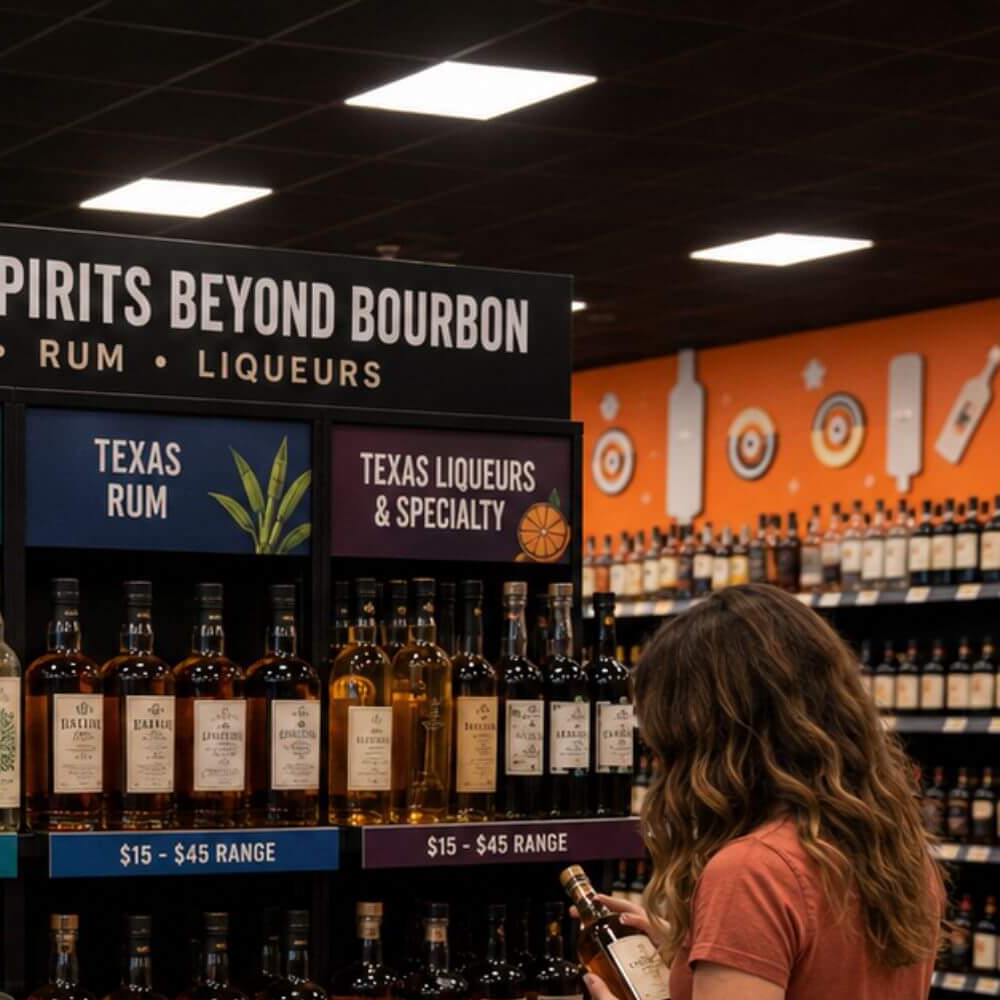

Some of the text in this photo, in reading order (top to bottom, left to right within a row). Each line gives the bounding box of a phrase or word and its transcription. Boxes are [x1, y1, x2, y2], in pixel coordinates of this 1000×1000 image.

[170, 269, 336, 340] BEYOND
[351, 286, 529, 353] BOURBON
[39, 338, 124, 372] RUM
[198, 349, 382, 388] LIQUEURS
[95, 438, 182, 476] TEXAS
[360, 452, 535, 493] TEXAS LIQUEURS
[107, 485, 167, 519] RUM
[374, 497, 505, 531] & SPECIALTY
[120, 842, 276, 866] $15 $45 RANGE
[427, 833, 568, 858] $15 $45 RANGE
